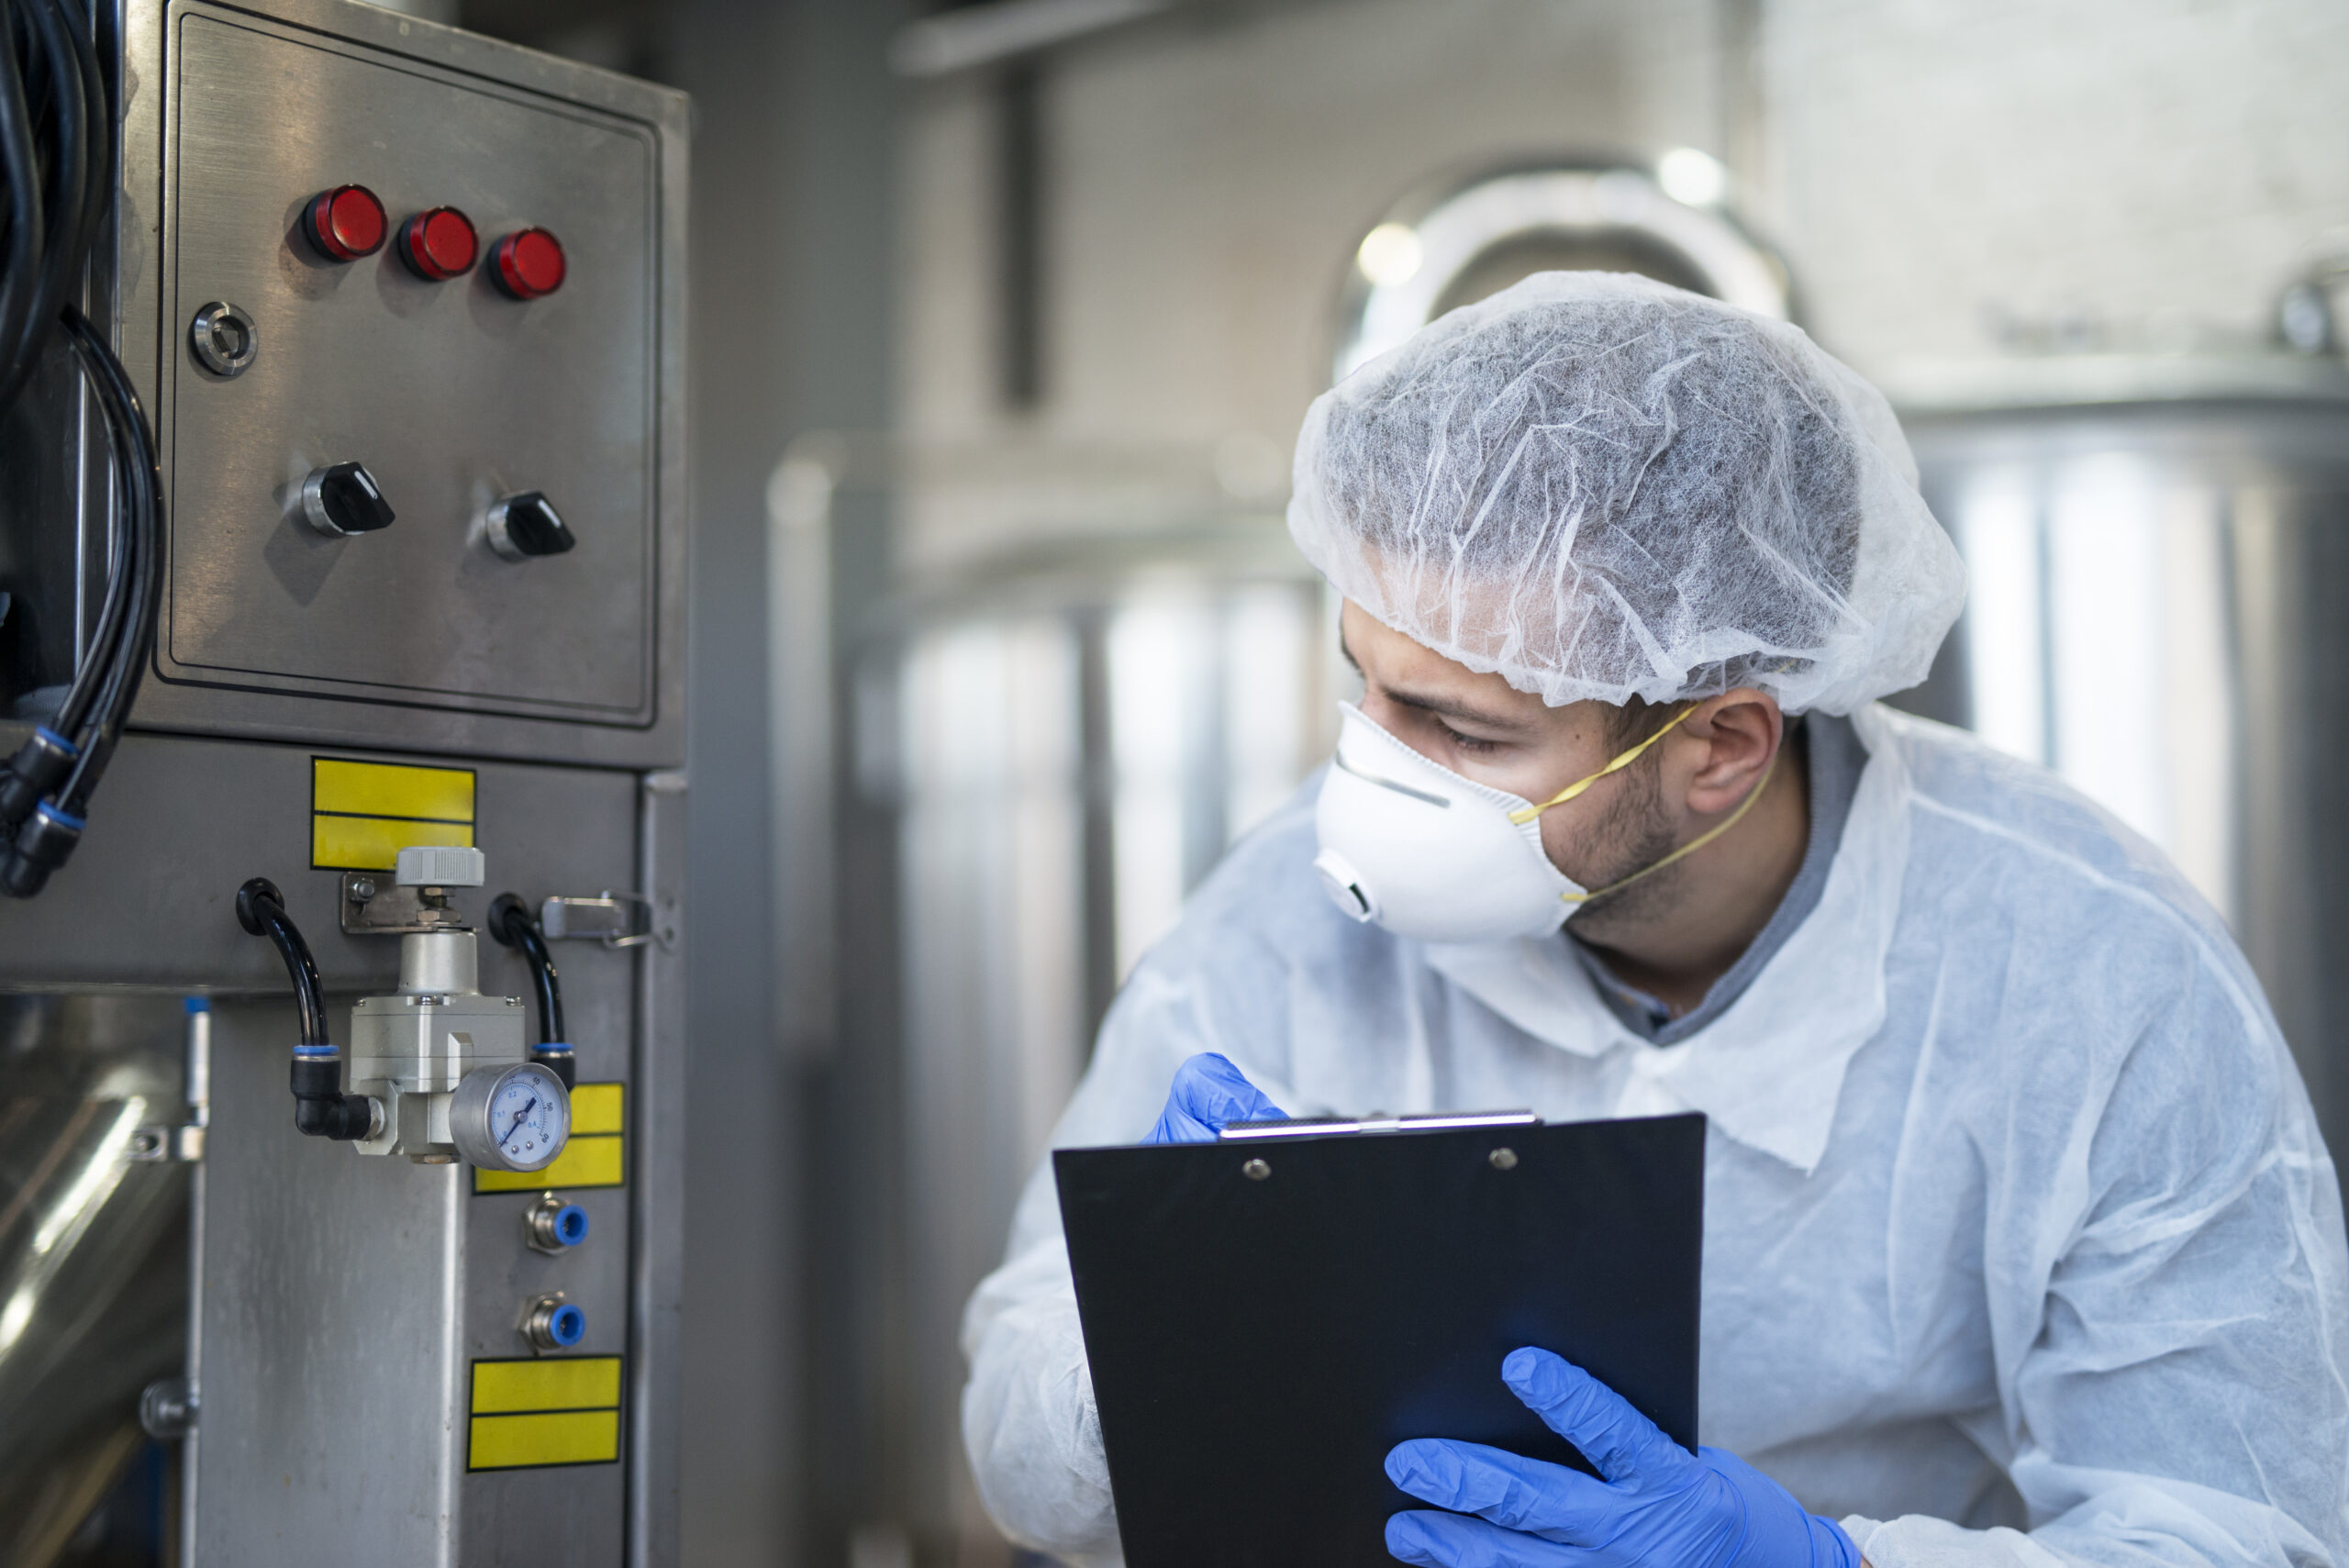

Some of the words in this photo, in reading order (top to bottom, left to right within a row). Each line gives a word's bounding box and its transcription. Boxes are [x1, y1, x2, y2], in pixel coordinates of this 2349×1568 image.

[533, 1076, 540, 1085] 40
[546, 1102, 553, 1112] 50
[541, 1133, 550, 1143] 60
